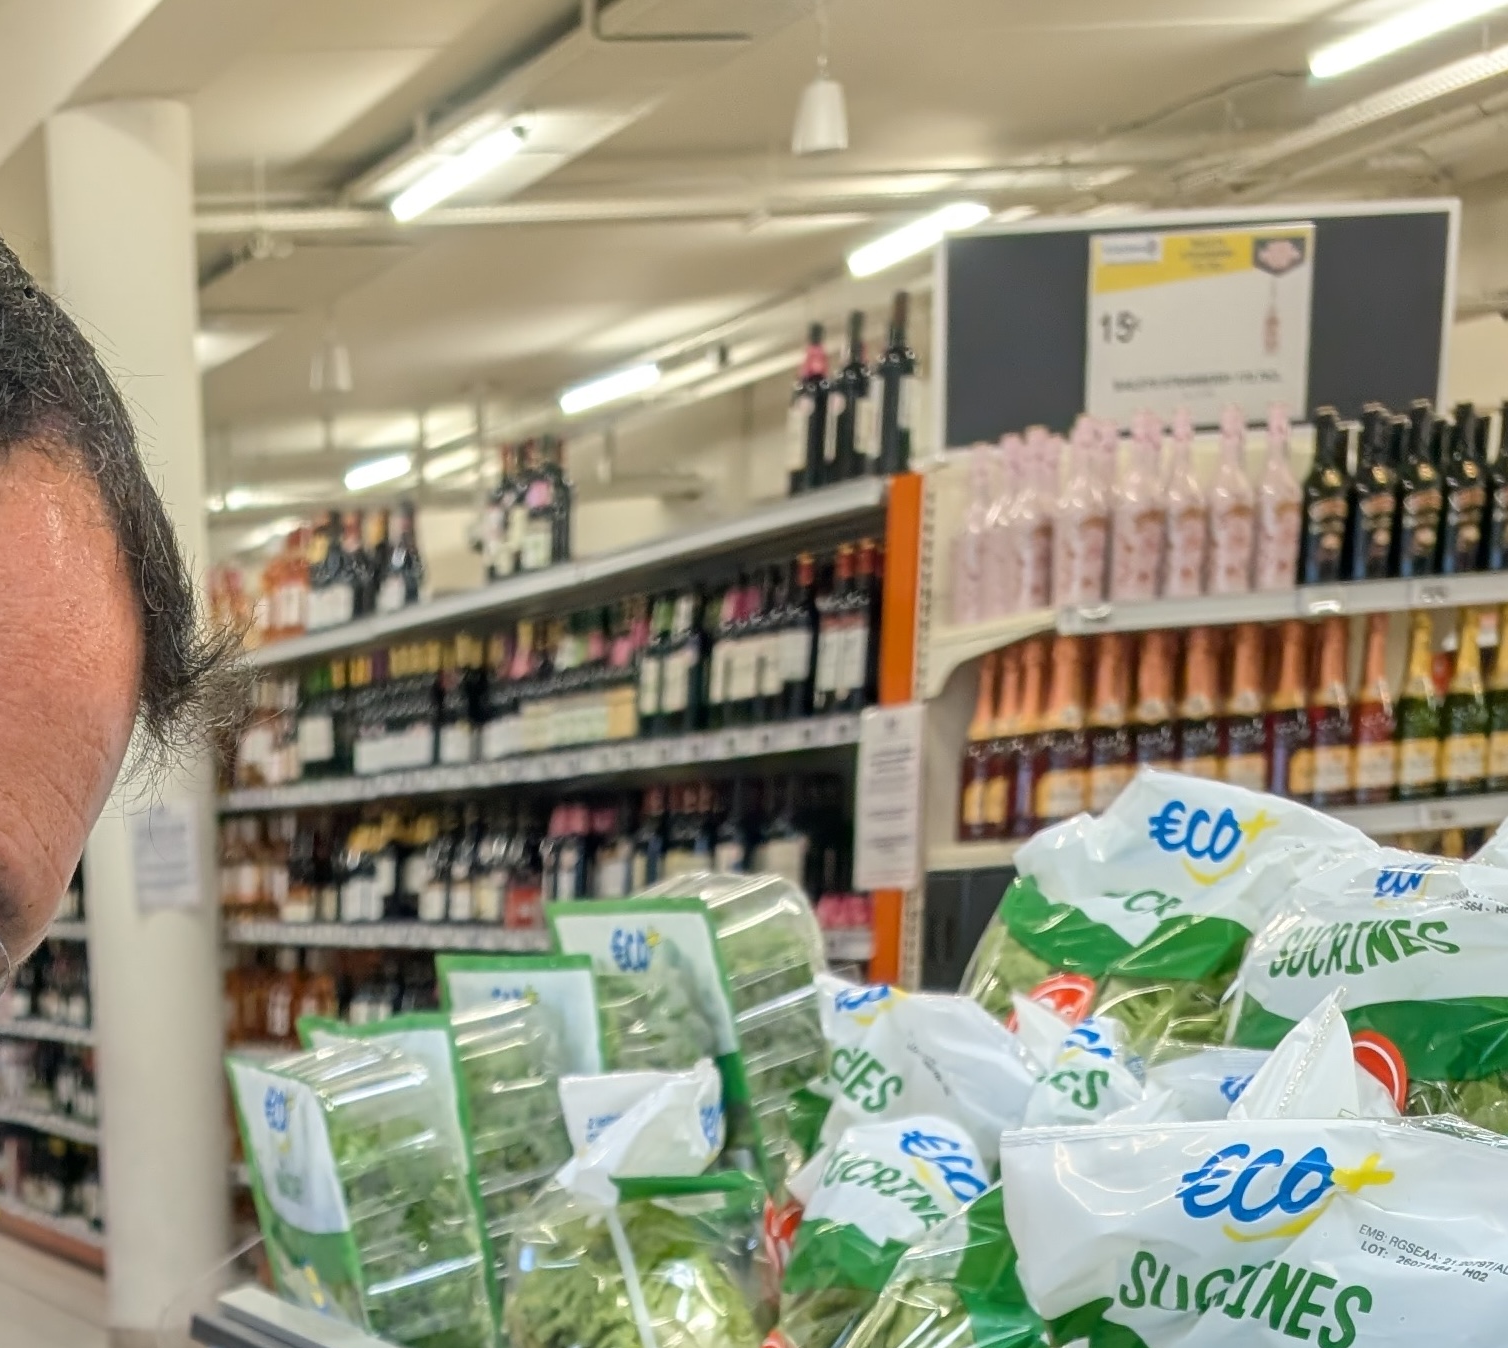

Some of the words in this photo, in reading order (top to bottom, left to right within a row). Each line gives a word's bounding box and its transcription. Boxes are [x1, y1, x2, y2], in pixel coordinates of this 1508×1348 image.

[1268, 918, 1461, 978] SUCRINES
[1359, 1223, 1388, 1243] EMB:
[1360, 1240, 1389, 1259] LOT:
[1462, 1268, 1489, 1282] H02
